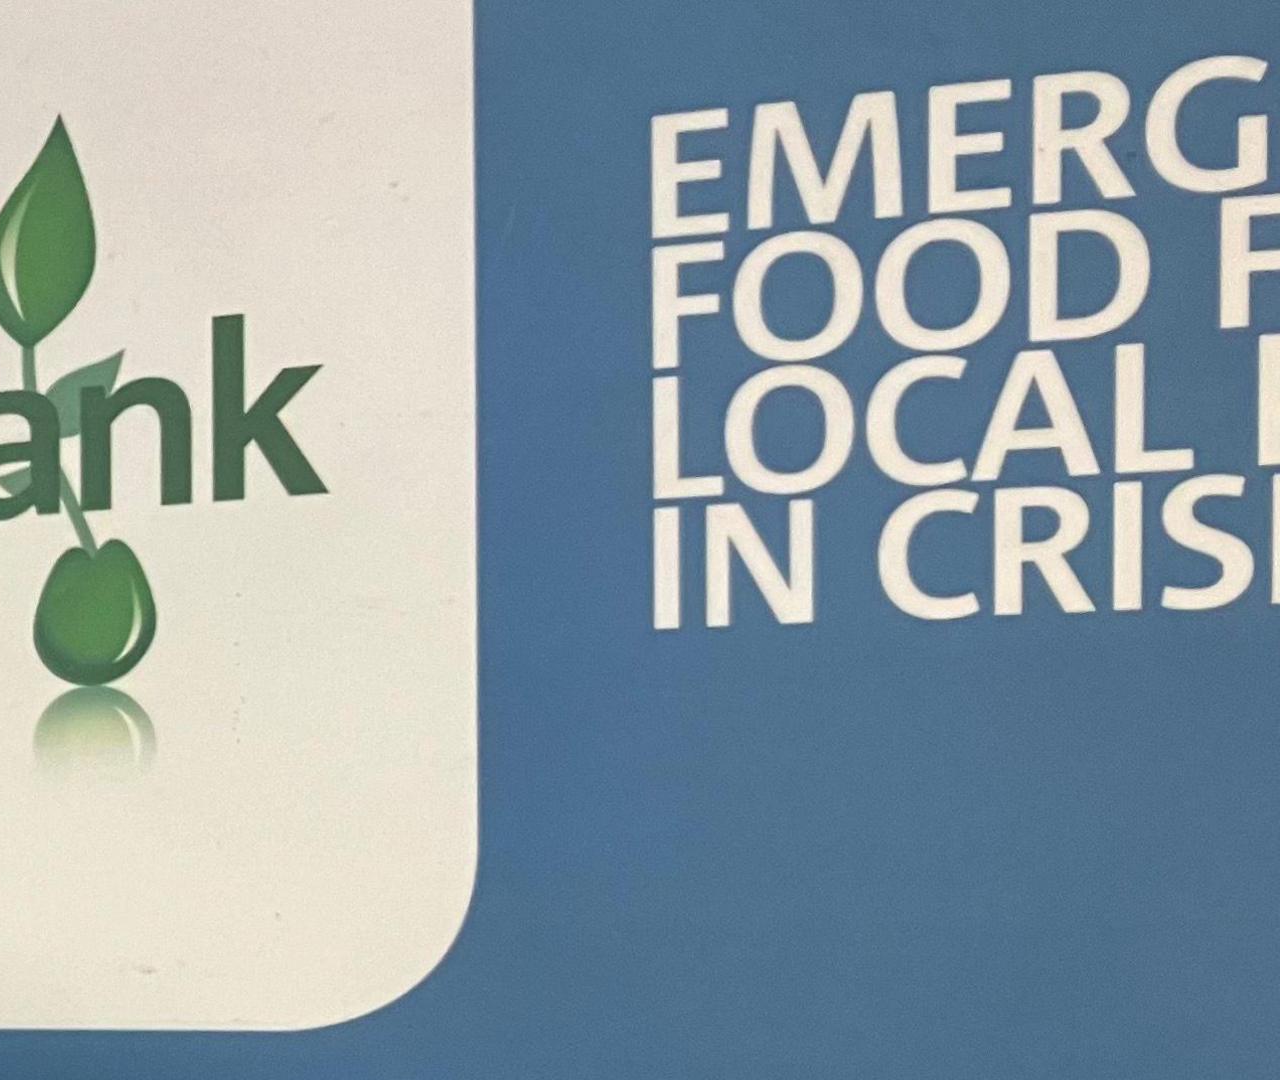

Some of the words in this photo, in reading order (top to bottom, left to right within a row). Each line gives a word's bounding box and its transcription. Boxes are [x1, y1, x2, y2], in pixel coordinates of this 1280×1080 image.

[651, 55, 1269, 239] EMERG
[652, 209, 1151, 370] FOOD
[652, 343, 1194, 500] LOCAL
[653, 499, 814, 630] IN
